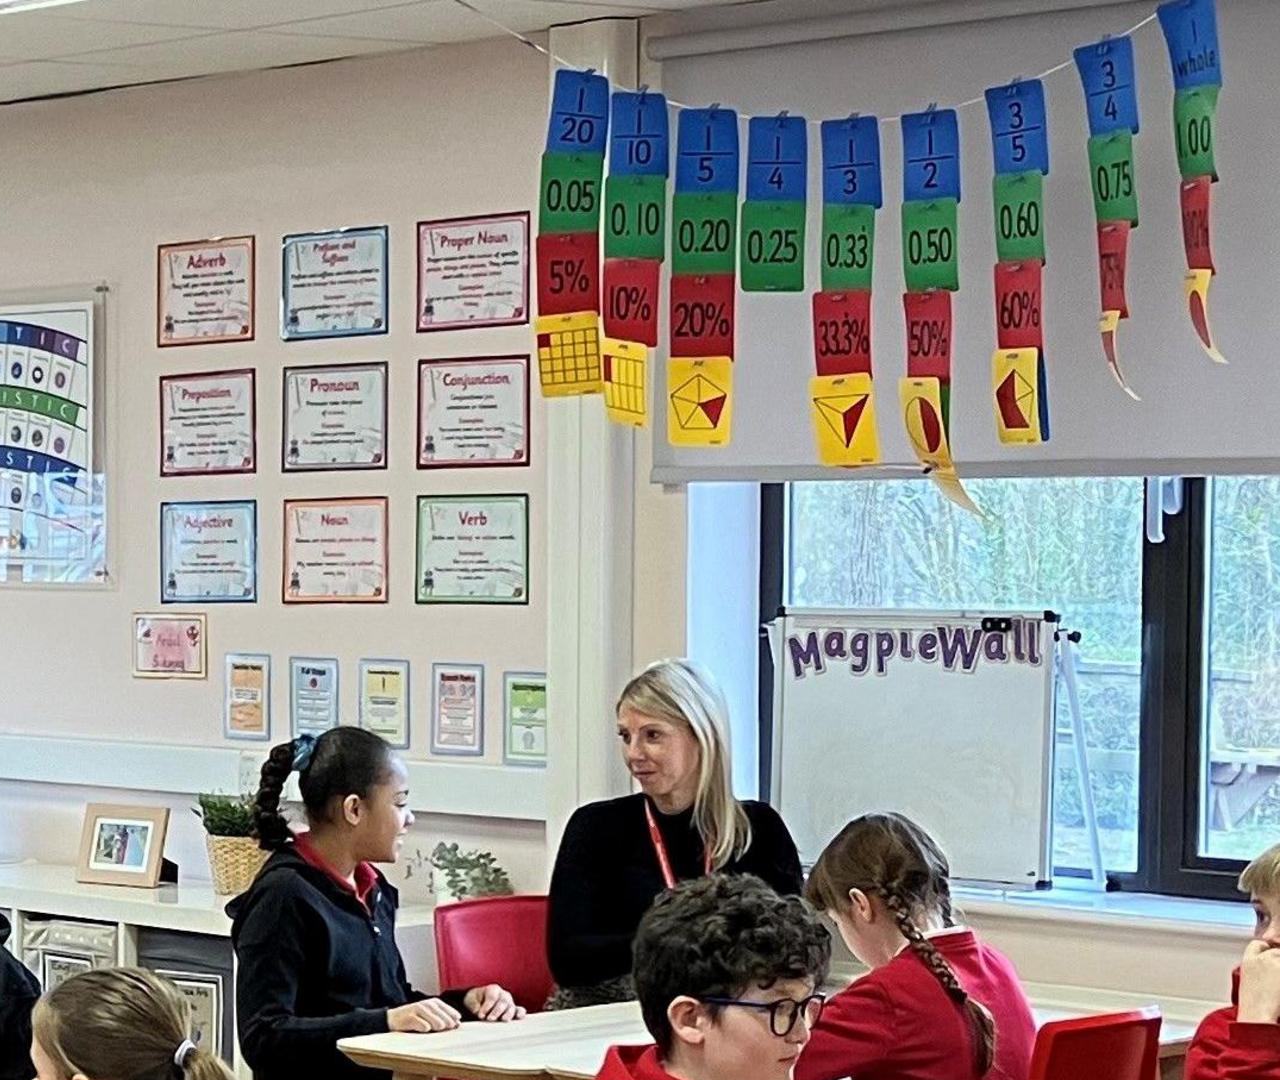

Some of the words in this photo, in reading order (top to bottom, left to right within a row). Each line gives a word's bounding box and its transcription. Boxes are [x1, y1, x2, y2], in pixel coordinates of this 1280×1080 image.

[1100, 60, 1116, 89] 3
[1176, 49, 1216, 77] whole
[1008, 101, 1024, 131] 3
[1103, 95, 1118, 121] 4
[560, 117, 594, 144] 20
[627, 139, 652, 165] 10
[1011, 134, 1026, 163] 5
[697, 156, 714, 183] 5
[768, 167, 784, 190] 4
[843, 169, 857, 195] 3
[922, 162, 938, 189] 2
[1097, 160, 1133, 202] 0.75
[546, 179, 595, 213] 0.05
[611, 202, 660, 236] 0.10
[999, 200, 1040, 240] 0.60
[440, 234, 474, 251] Proper
[477, 230, 508, 245] Noun
[678, 218, 731, 253] 0.20
[747, 229, 799, 264] 0.25
[908, 227, 953, 265] 0.50
[186, 252, 226, 269] Adverb
[548, 258, 590, 295] 5%
[609, 285, 651, 321] 10%
[1000, 290, 1040, 330] 60%
[674, 301, 731, 338] 20%
[909, 319, 948, 358] 50%
[310, 378, 360, 392] Pronoun
[443, 372, 510, 391] Conjunction
[321, 513, 348, 526] Noun
[459, 511, 487, 526] Verb
